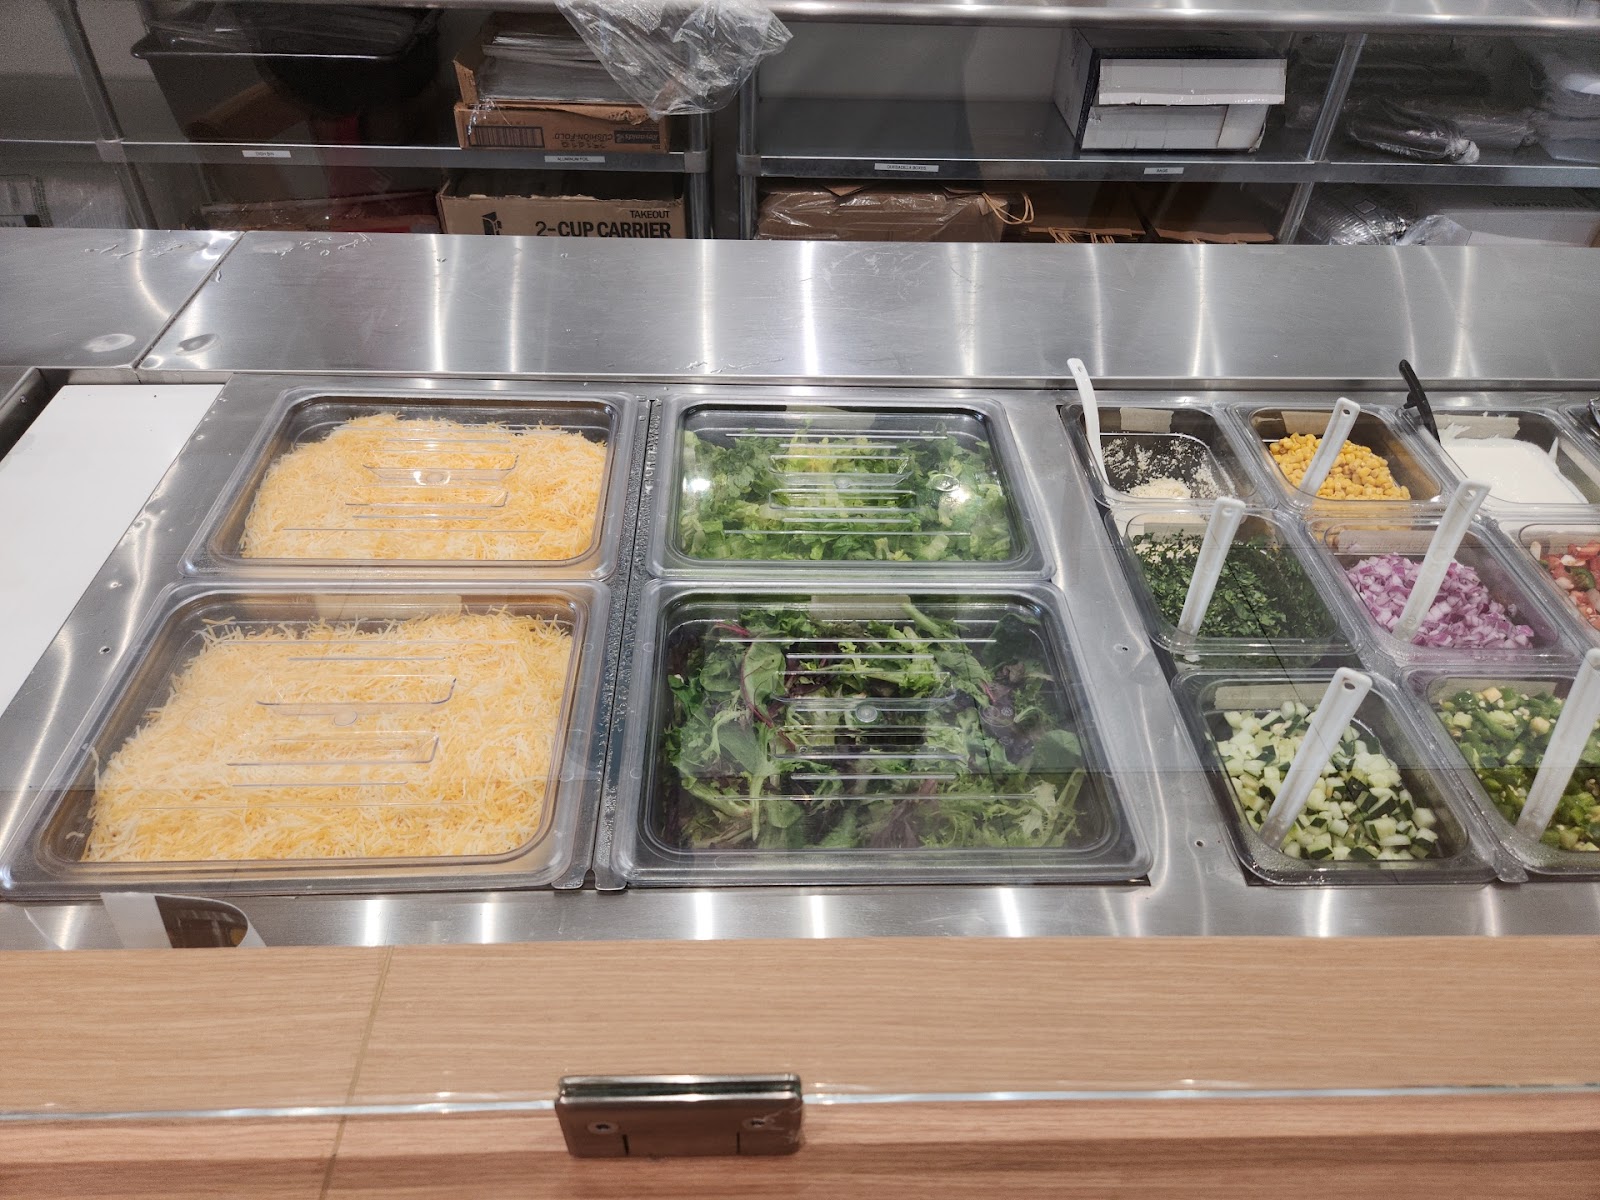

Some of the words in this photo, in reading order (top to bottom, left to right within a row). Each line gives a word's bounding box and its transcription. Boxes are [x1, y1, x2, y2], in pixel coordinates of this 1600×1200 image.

[630, 210, 670, 219] TAKEOUT
[535, 220, 594, 237] 2-CUP
[597, 221, 672, 238] CARRIER
